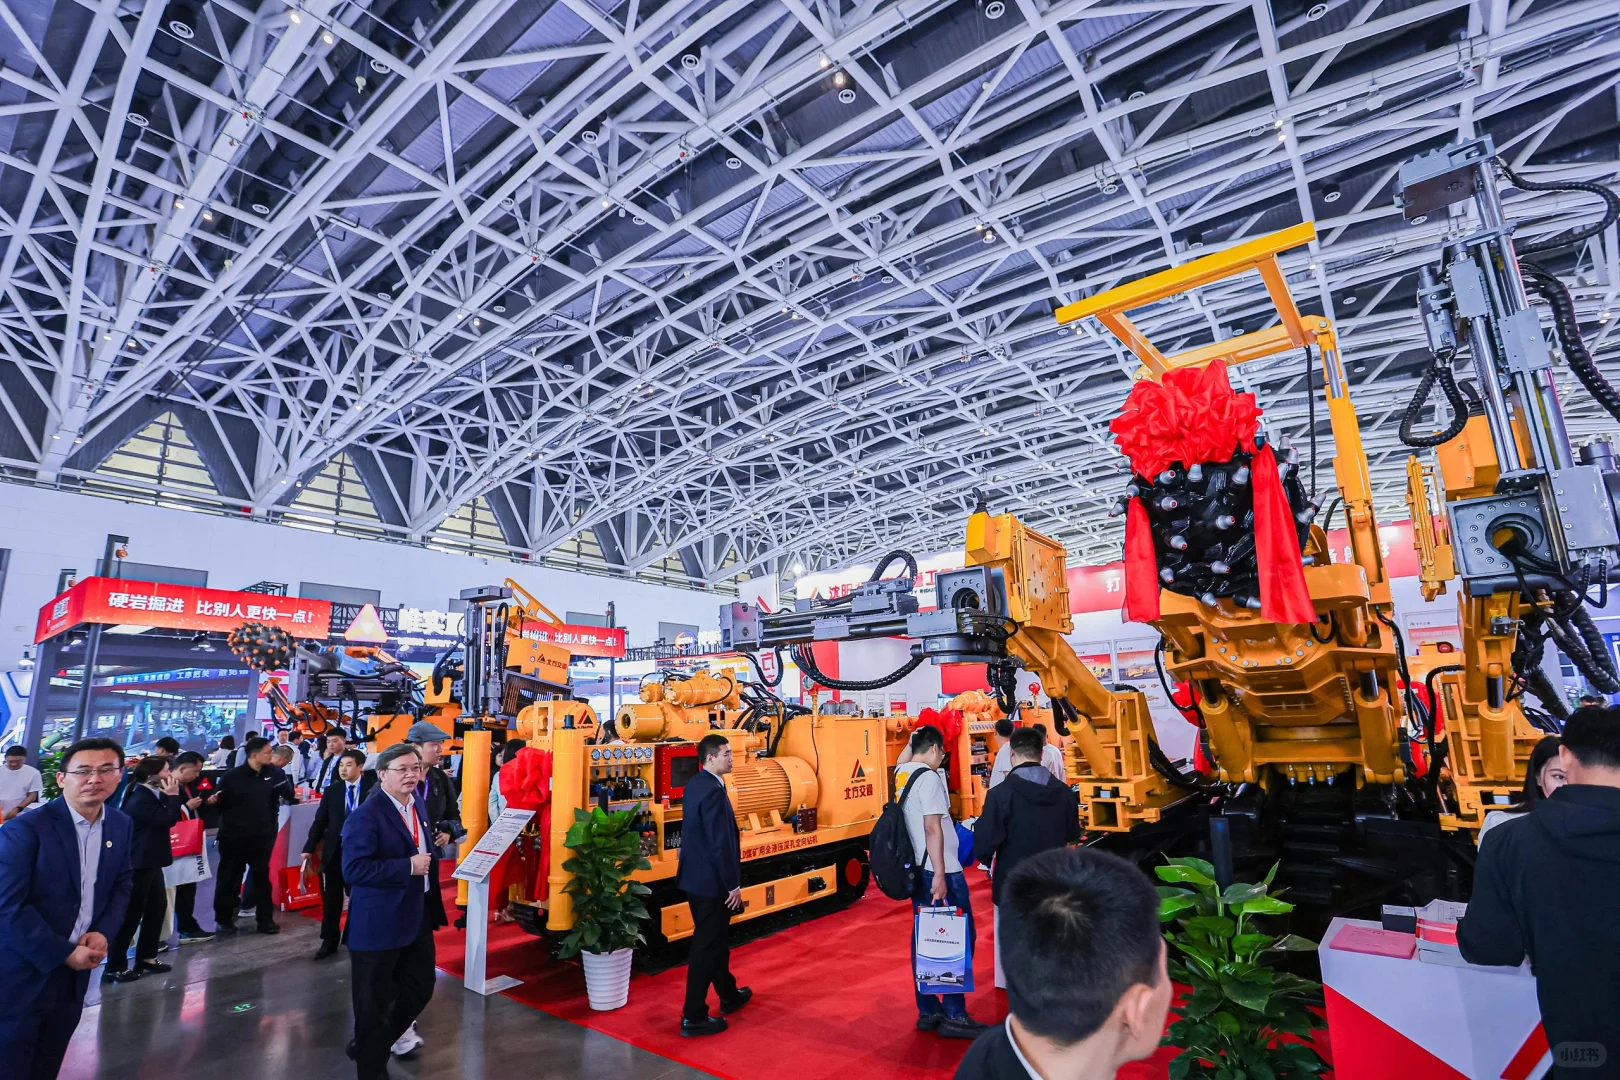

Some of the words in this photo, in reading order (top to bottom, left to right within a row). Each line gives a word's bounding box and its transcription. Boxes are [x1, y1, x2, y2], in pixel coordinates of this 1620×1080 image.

[108, 591, 185, 614] 硬岩掘进
[195, 599, 313, 624] 比别人更快一点!
[553, 631, 618, 647] 比别人更快一点!
